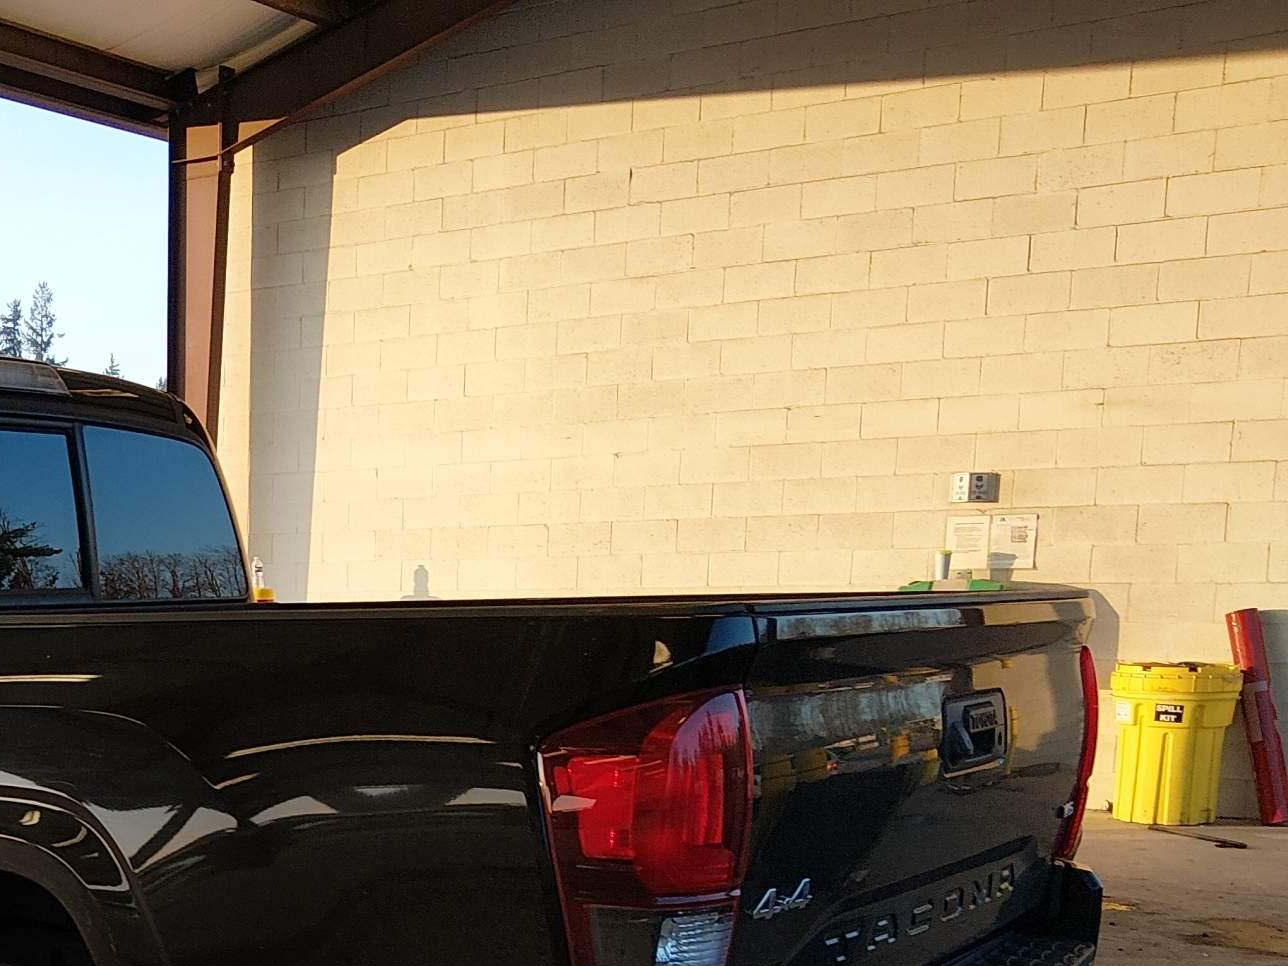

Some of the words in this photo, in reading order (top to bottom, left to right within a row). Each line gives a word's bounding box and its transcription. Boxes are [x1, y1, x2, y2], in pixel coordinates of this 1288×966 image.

[1156, 705, 1182, 713] SPILL
[1159, 714, 1177, 722] KIT
[822, 863, 1015, 963] TACOMA
